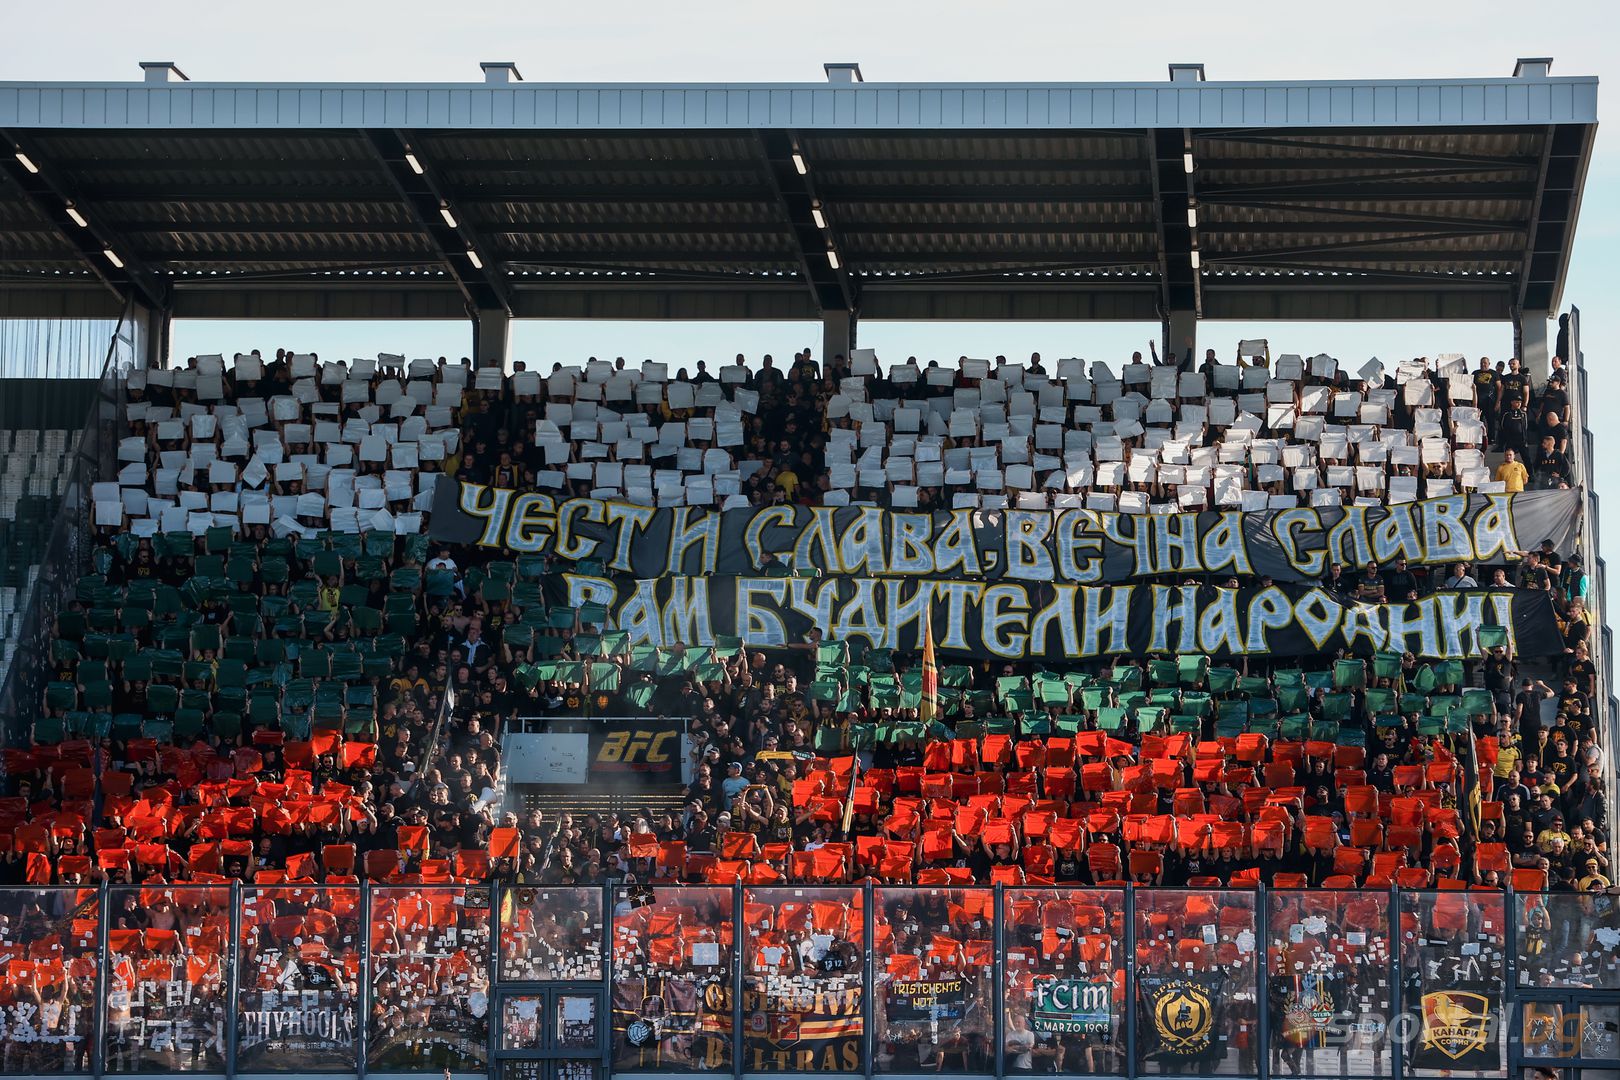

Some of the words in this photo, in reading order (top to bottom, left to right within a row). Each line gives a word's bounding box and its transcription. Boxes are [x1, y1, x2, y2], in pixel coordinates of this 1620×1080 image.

[460, 481, 657, 573] ЧЕСТ
[666, 504, 722, 577] И
[1003, 508, 1253, 582] ВЕЧНА
[1273, 493, 1521, 576] СЛАВА
[735, 577, 1136, 657] БУДИТЕЛИ
[1035, 1021, 1041, 1030] 9
[1043, 1022, 1081, 1033] MARZO
[1085, 1023, 1109, 1033] 1908
[1432, 1028, 1479, 1037] КАНАРИ
[1441, 1038, 1469, 1046] СОФИЯ
[705, 1037, 859, 1072] BLTRAS
